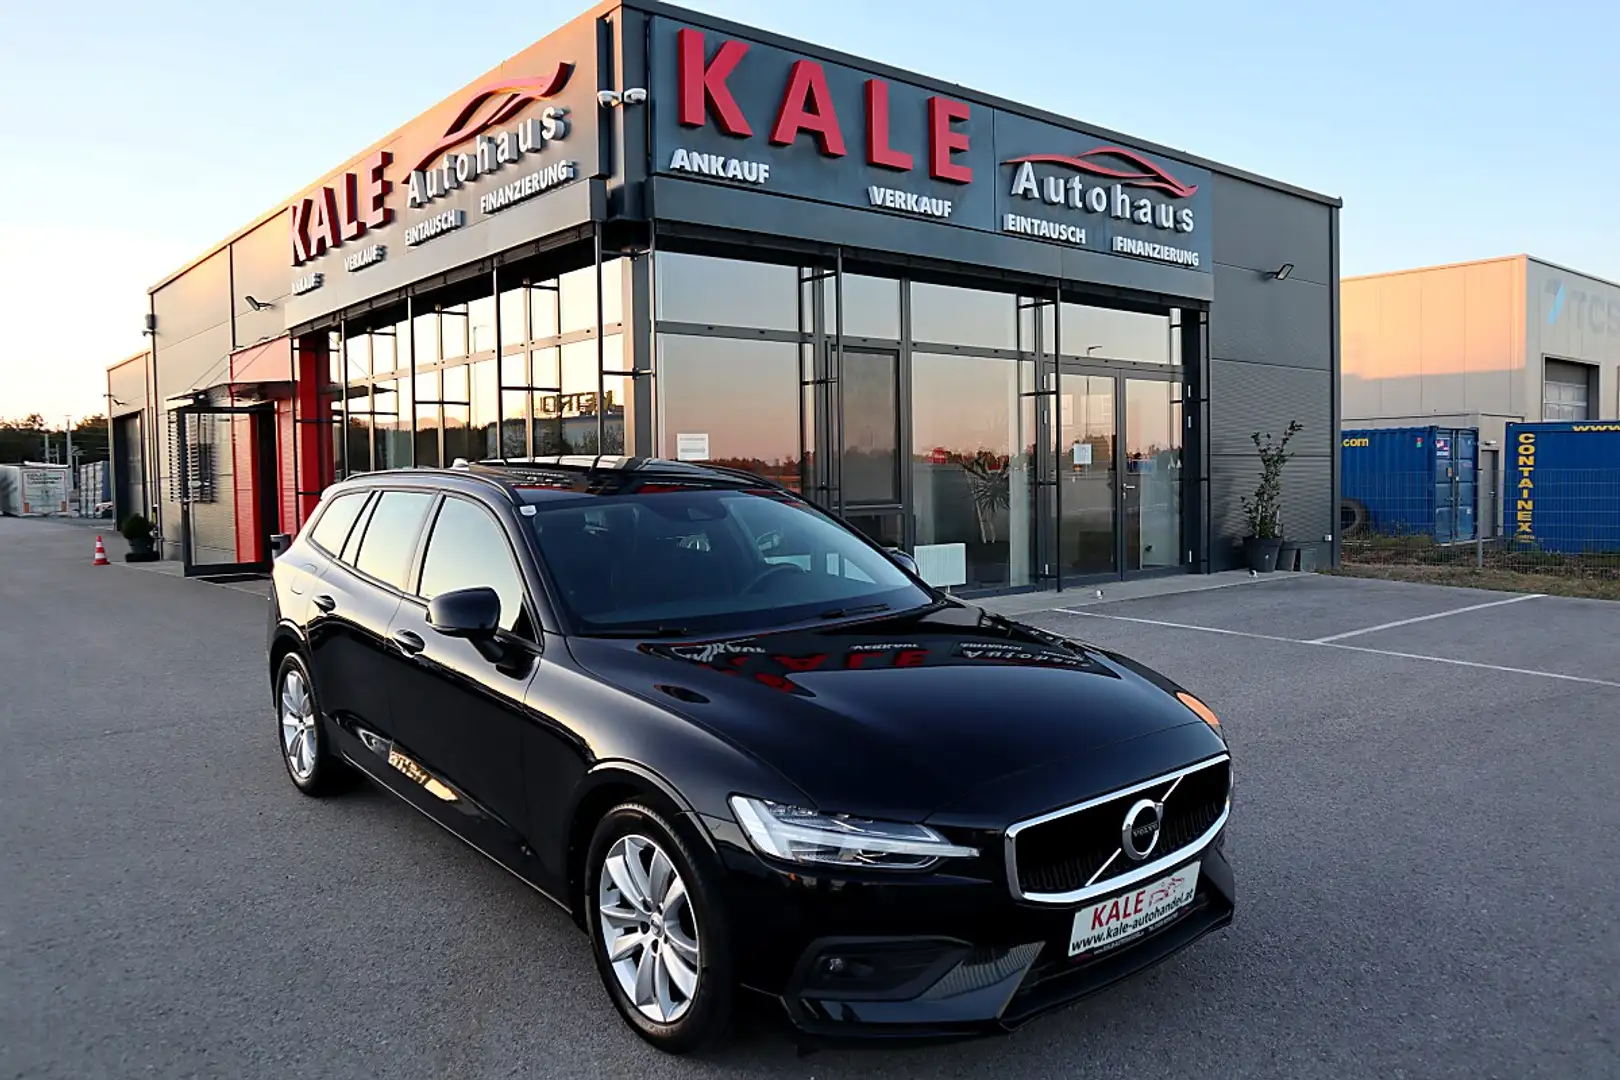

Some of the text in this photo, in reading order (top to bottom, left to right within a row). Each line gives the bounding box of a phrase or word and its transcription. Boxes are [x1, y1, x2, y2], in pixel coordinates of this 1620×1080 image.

[677, 27, 973, 185] KALE
[406, 106, 566, 208] Autohaus
[669, 148, 952, 218] ANKAUF VERKAUF
[287, 150, 394, 266] KALE
[404, 209, 465, 246] EINTAUSCH
[480, 160, 575, 214] FINANZIERUNG
[1010, 160, 1195, 233] Autohaus
[1003, 213, 1200, 267] EINTAUSCH FINANZIERUNG
[1517, 433, 1535, 532] CONTAINEX
[1133, 821, 1158, 837] VOLVO
[1071, 888, 1194, 952] www.kale-autohandel.at
[1091, 890, 1146, 930] KALE
